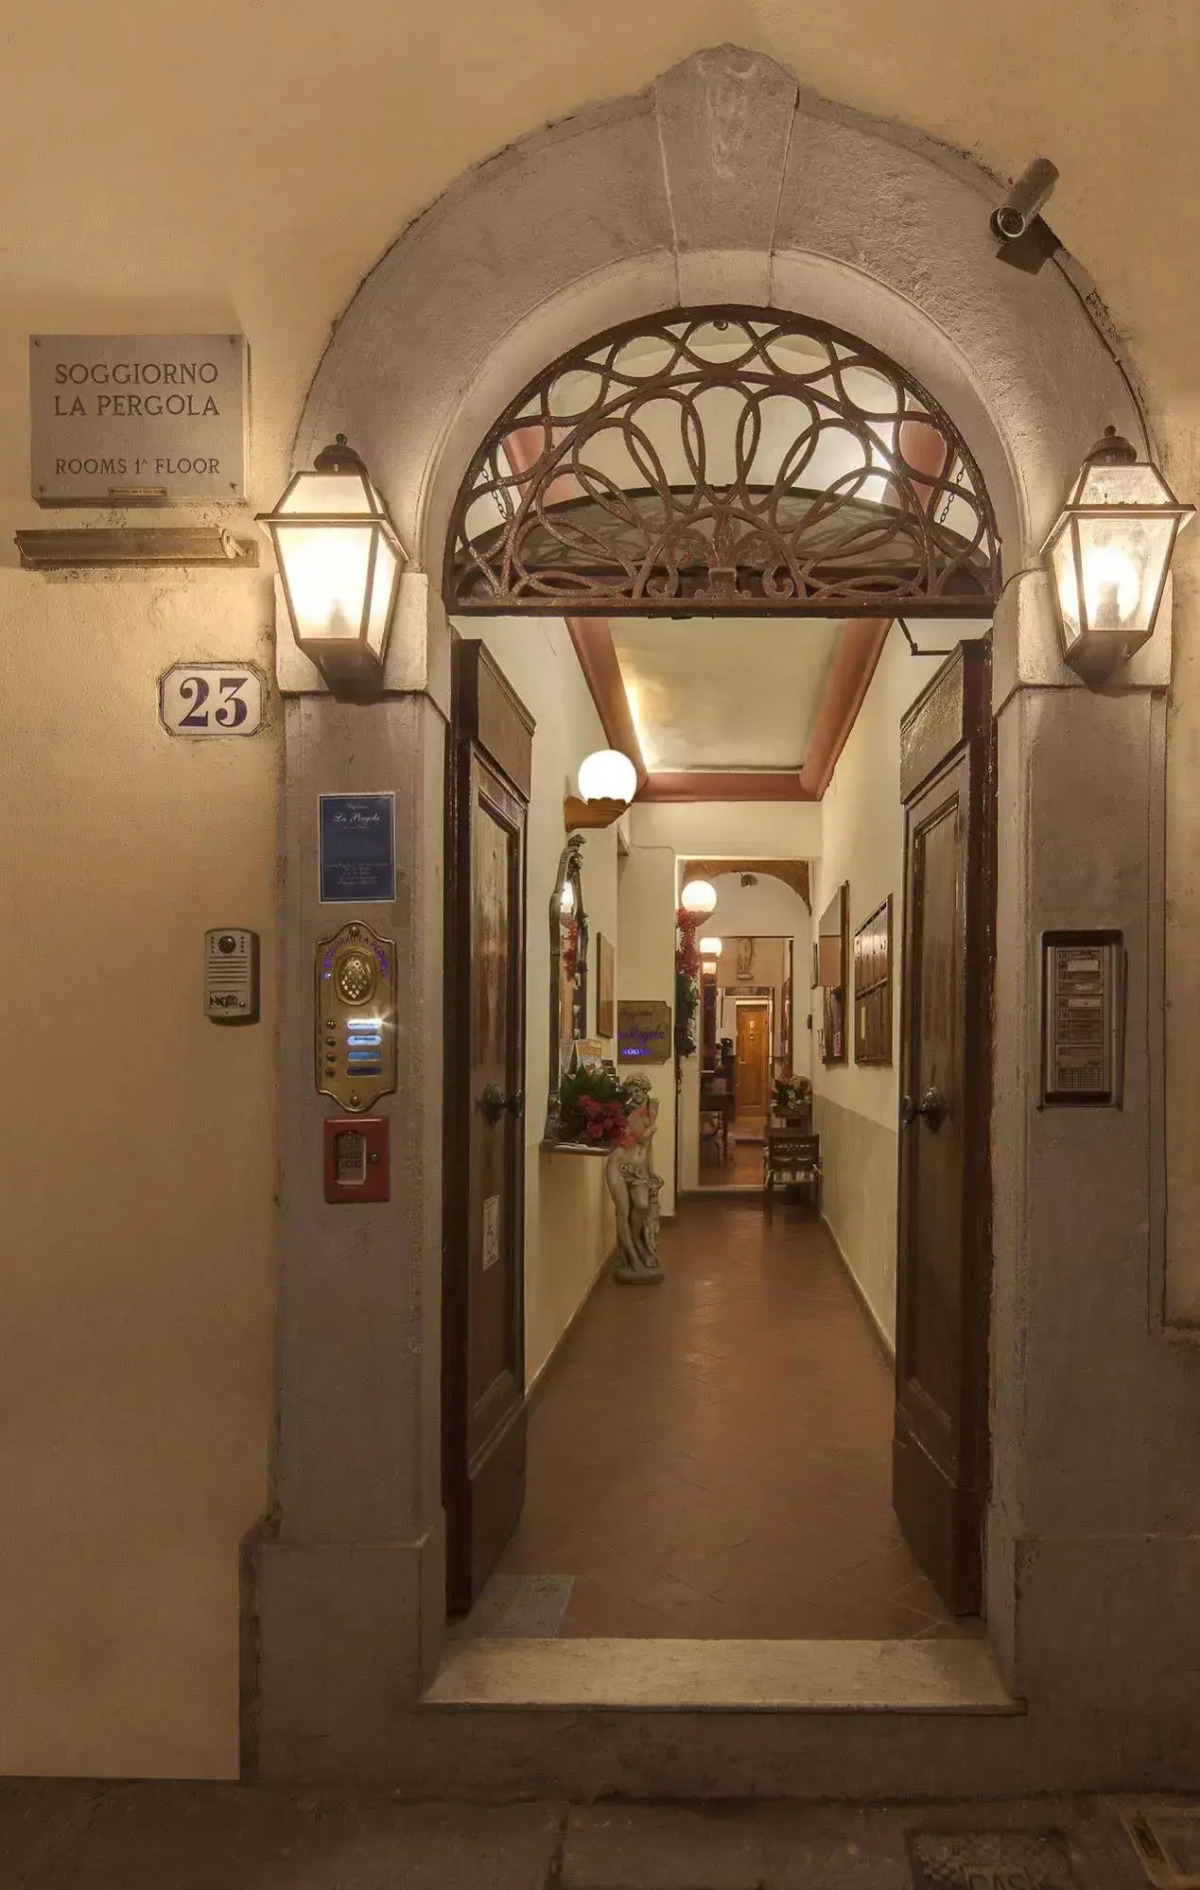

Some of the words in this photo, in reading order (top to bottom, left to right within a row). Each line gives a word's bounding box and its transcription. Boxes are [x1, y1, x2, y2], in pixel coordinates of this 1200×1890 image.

[55, 363, 219, 384] SOGGIORNO
[54, 395, 88, 416] LA
[97, 395, 220, 416] PERGOLA
[55, 459, 127, 475] ROOMS
[156, 458, 220, 474] FLOOR
[178, 677, 248, 727] 23
